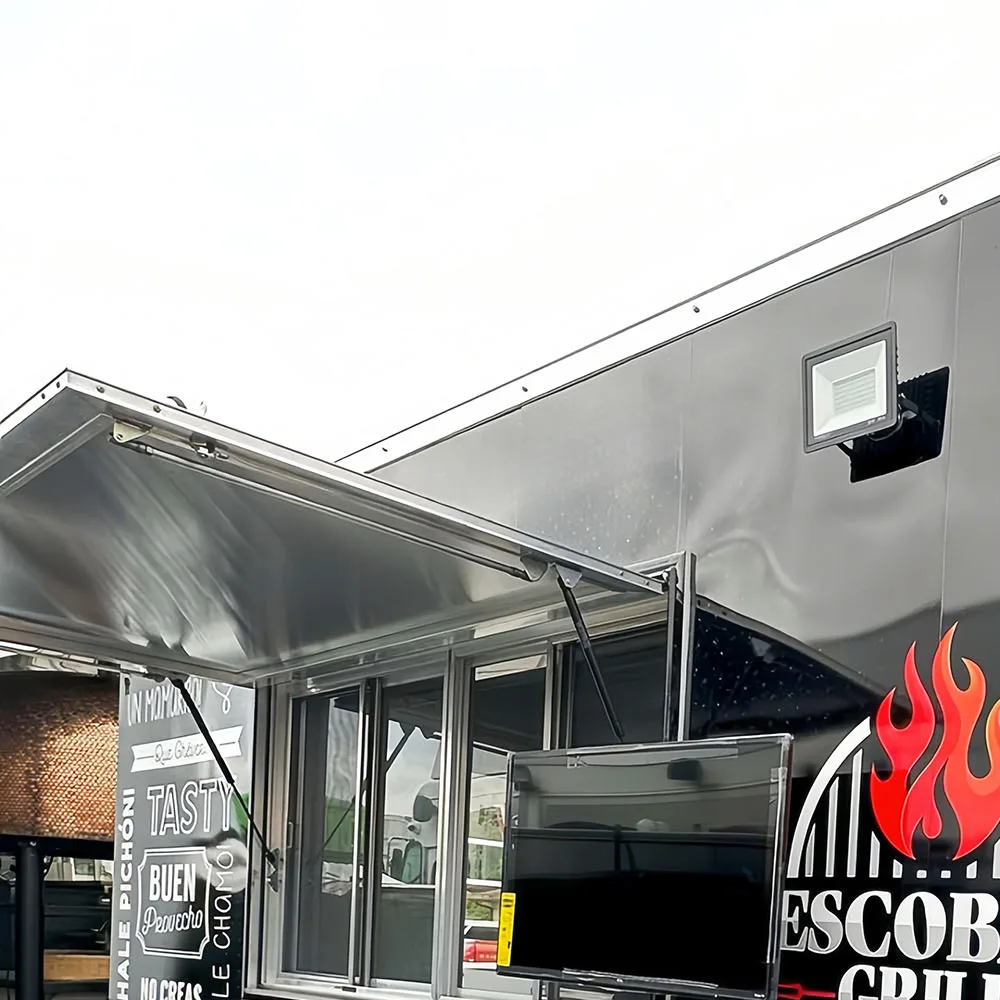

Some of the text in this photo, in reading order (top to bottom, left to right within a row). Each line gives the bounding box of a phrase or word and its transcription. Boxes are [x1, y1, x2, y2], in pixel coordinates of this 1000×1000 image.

[146, 774, 238, 837] TASTY
[149, 862, 197, 903] BUEN
[141, 905, 204, 936] Provecho
[139, 976, 158, 1000] NO
